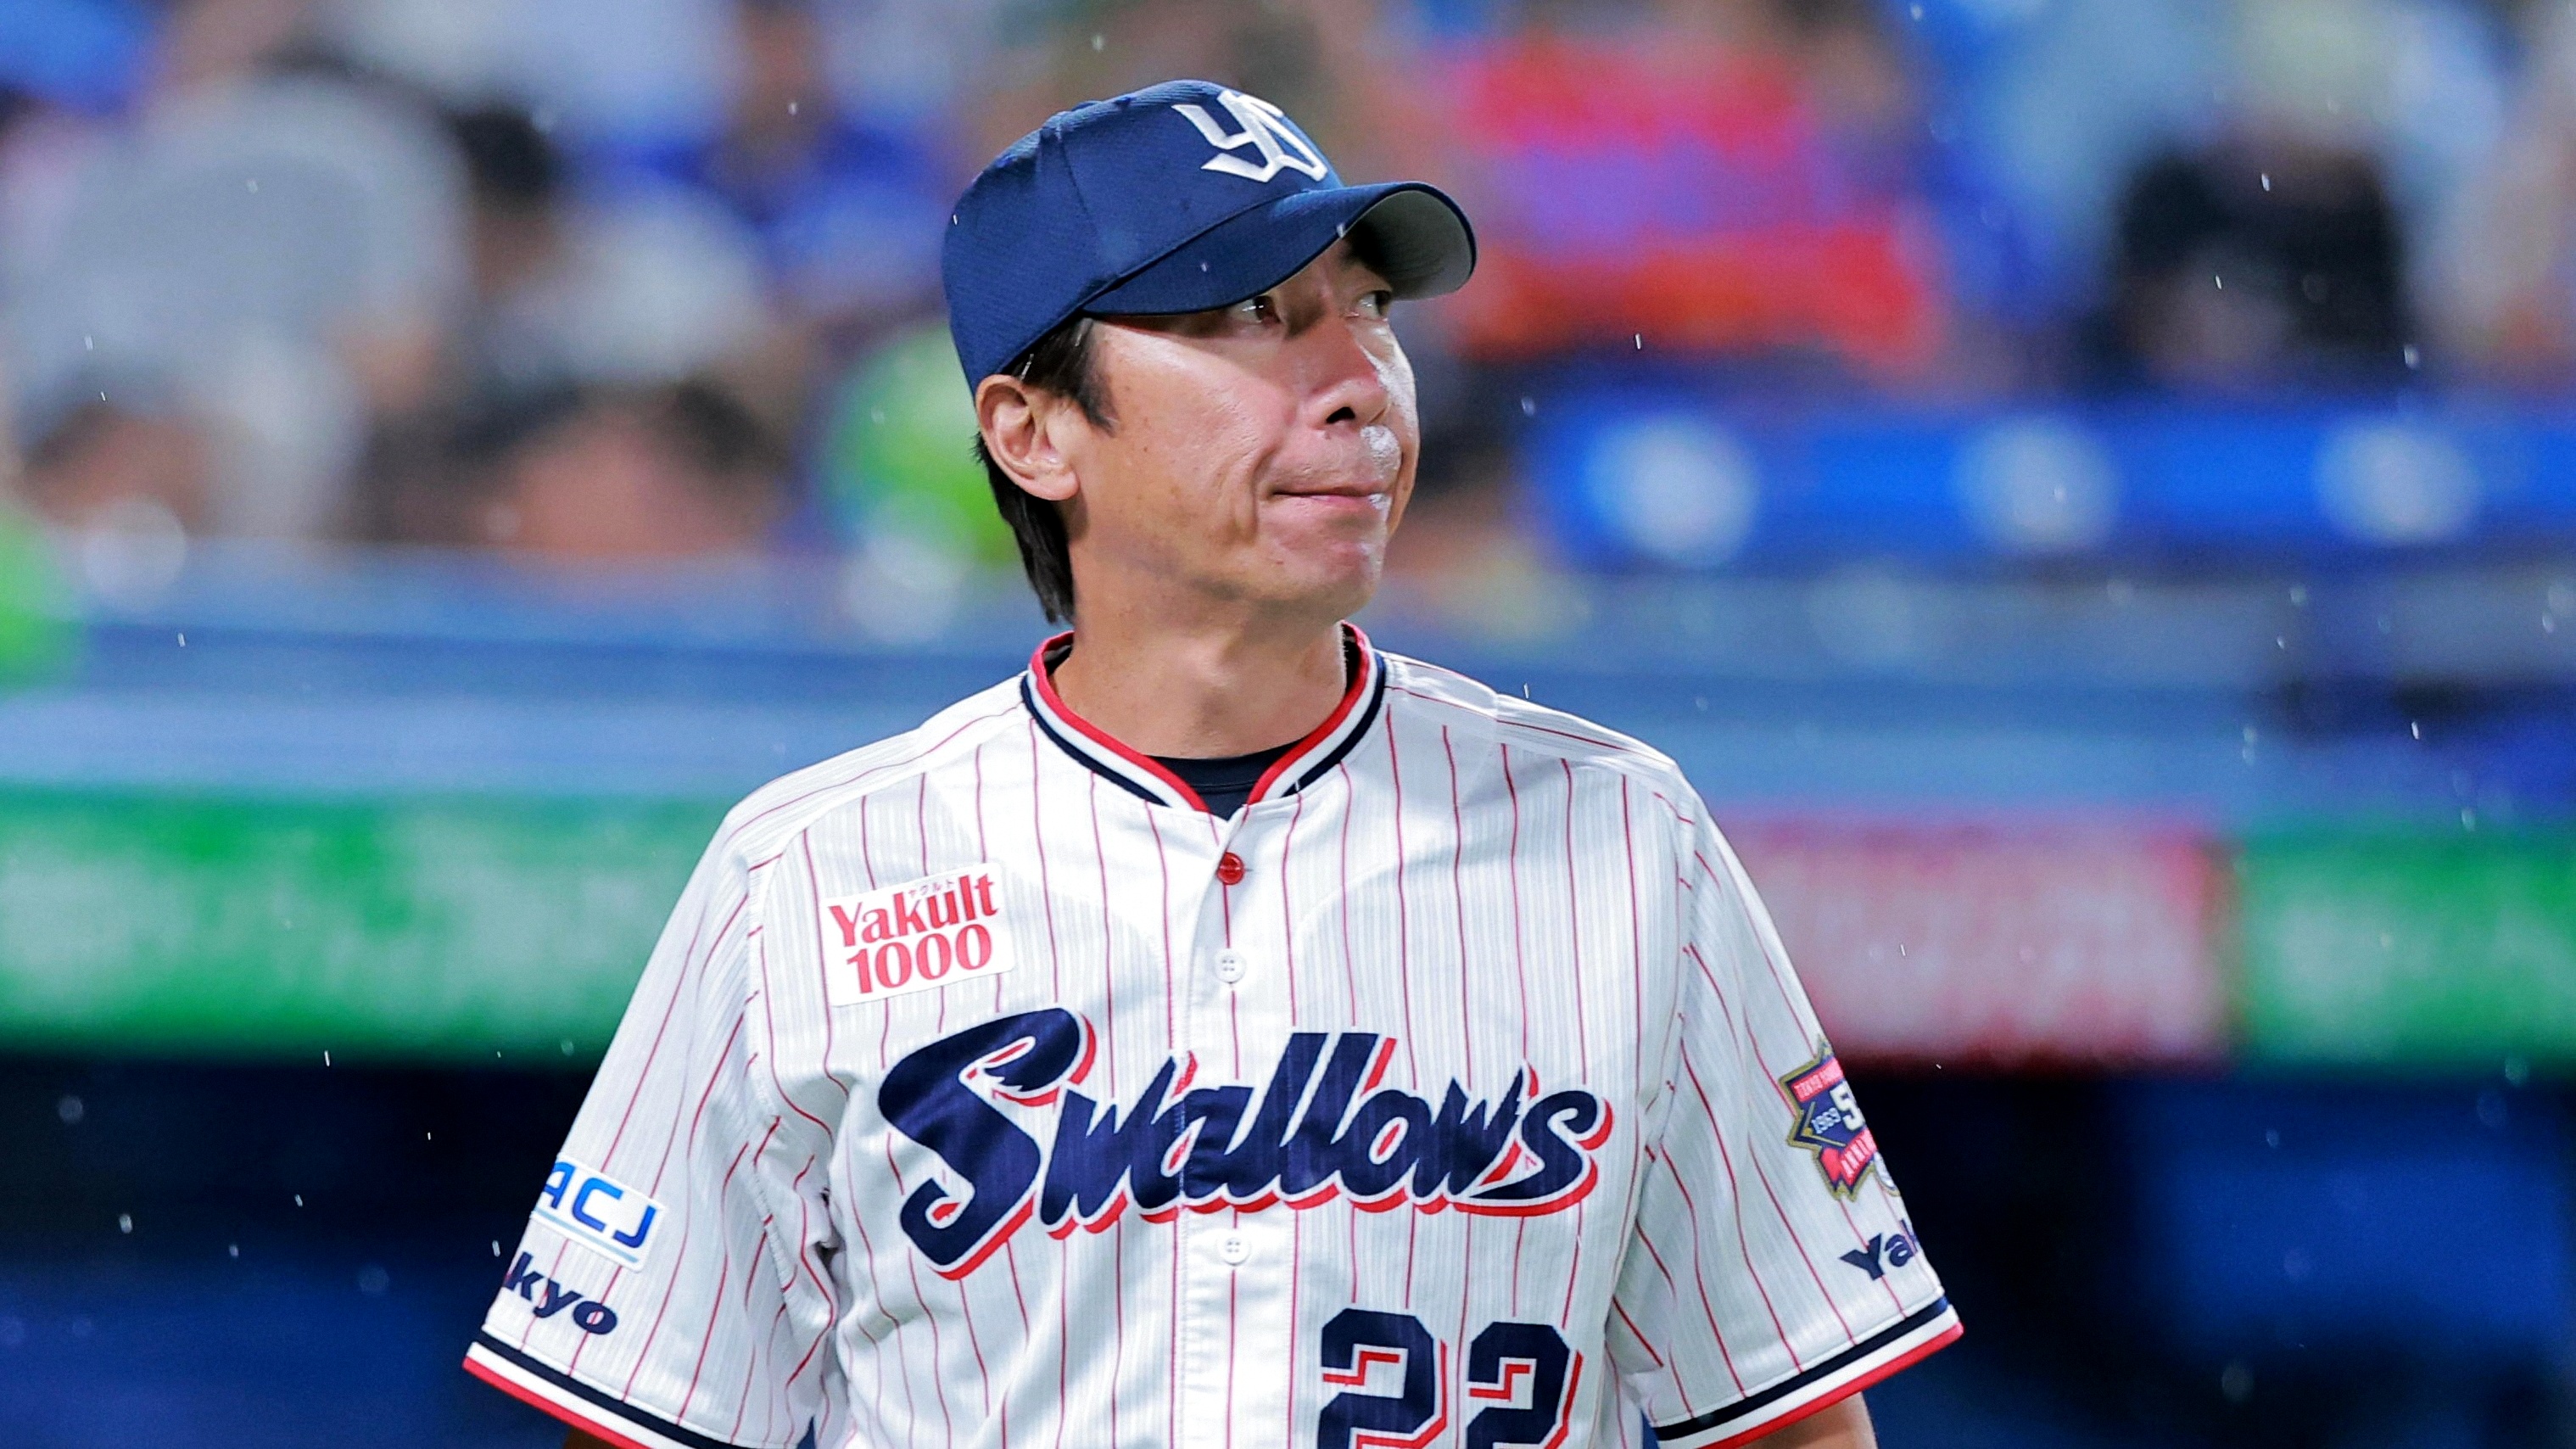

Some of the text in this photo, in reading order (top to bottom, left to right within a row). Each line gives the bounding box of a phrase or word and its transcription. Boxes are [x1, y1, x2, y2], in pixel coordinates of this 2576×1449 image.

[828, 873, 999, 948] Yakult
[846, 923, 992, 994] 1000
[877, 1006, 1613, 1282] Swallows
[503, 1251, 617, 1335] kyo
[1316, 1307, 1584, 1449] 22
